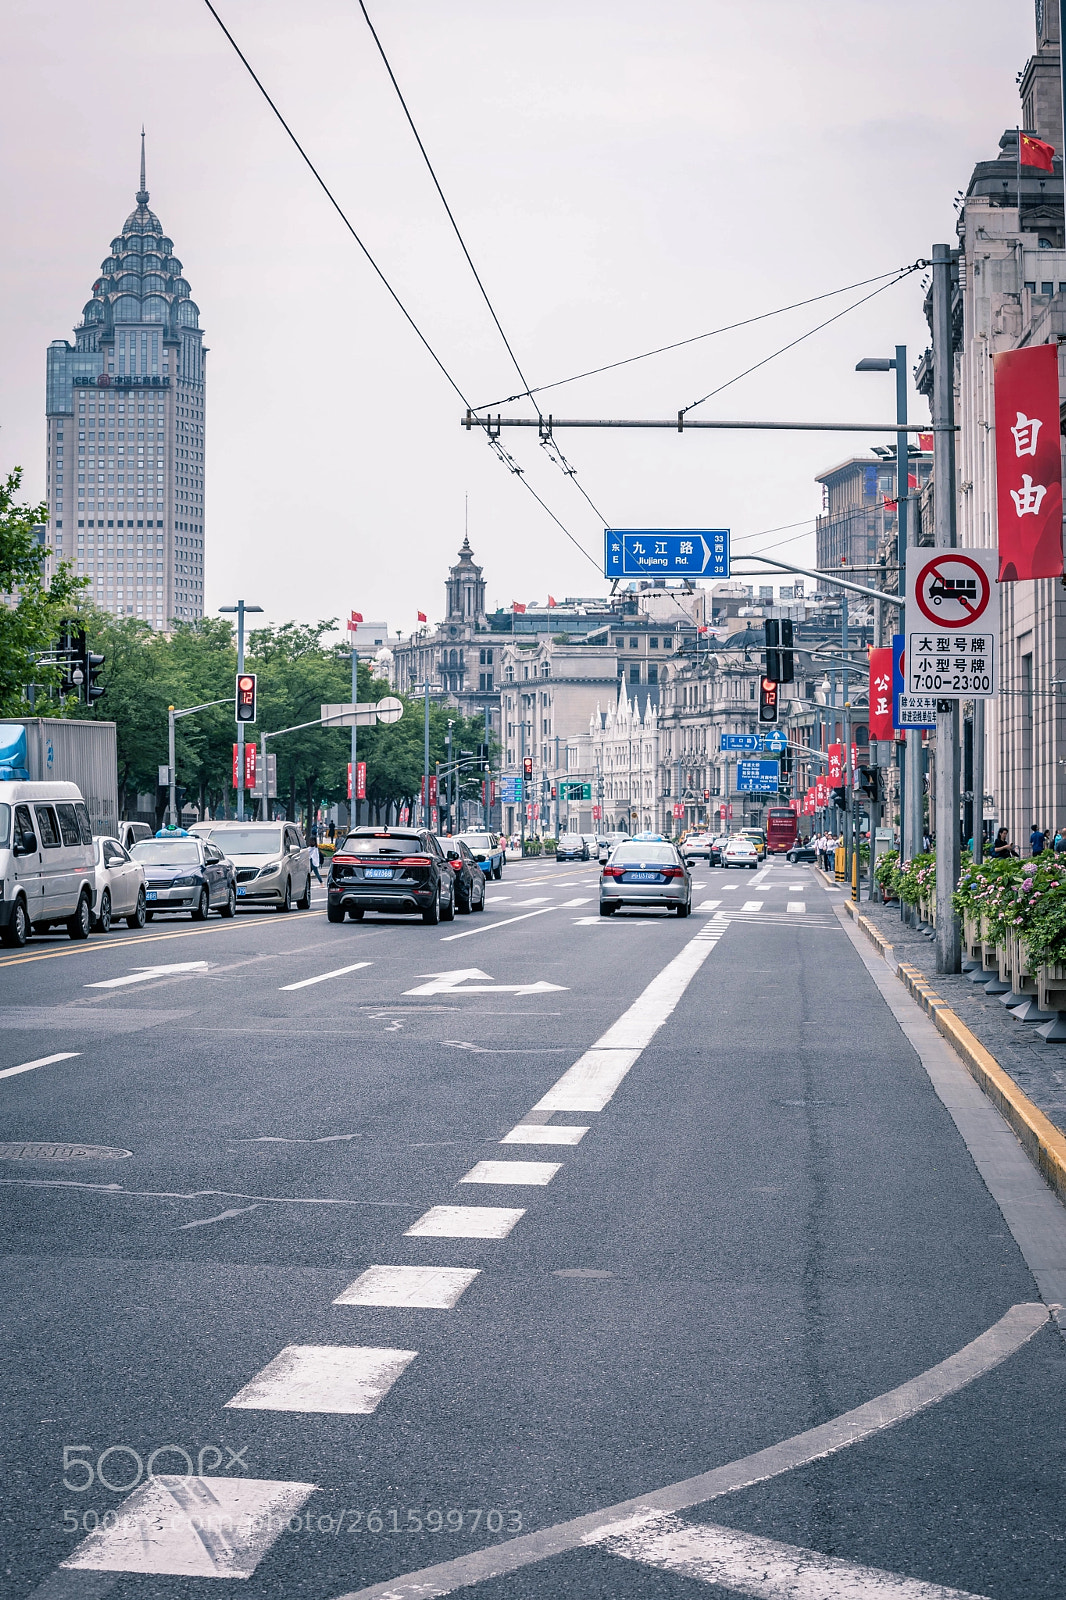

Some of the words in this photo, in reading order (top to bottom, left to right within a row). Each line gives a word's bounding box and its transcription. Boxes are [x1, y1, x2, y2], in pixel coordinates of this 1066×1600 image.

[72, 376, 96, 385] ICBC
[114, 375, 170, 385] 中国工商银行
[1009, 411, 1047, 518] 自由
[611, 543, 620, 552] 东
[632, 541, 694, 554] 九江路
[714, 544, 724, 552] 西
[612, 555, 619, 563] E
[637, 556, 668, 567] Jiujiang
[675, 556, 689, 565] Rd.
[918, 637, 986, 652] 大型号牌
[918, 658, 986, 673] 小型号牌
[243, 691, 253, 704] 12
[766, 692, 776, 705] 12
[873, 673, 891, 716] 公正
